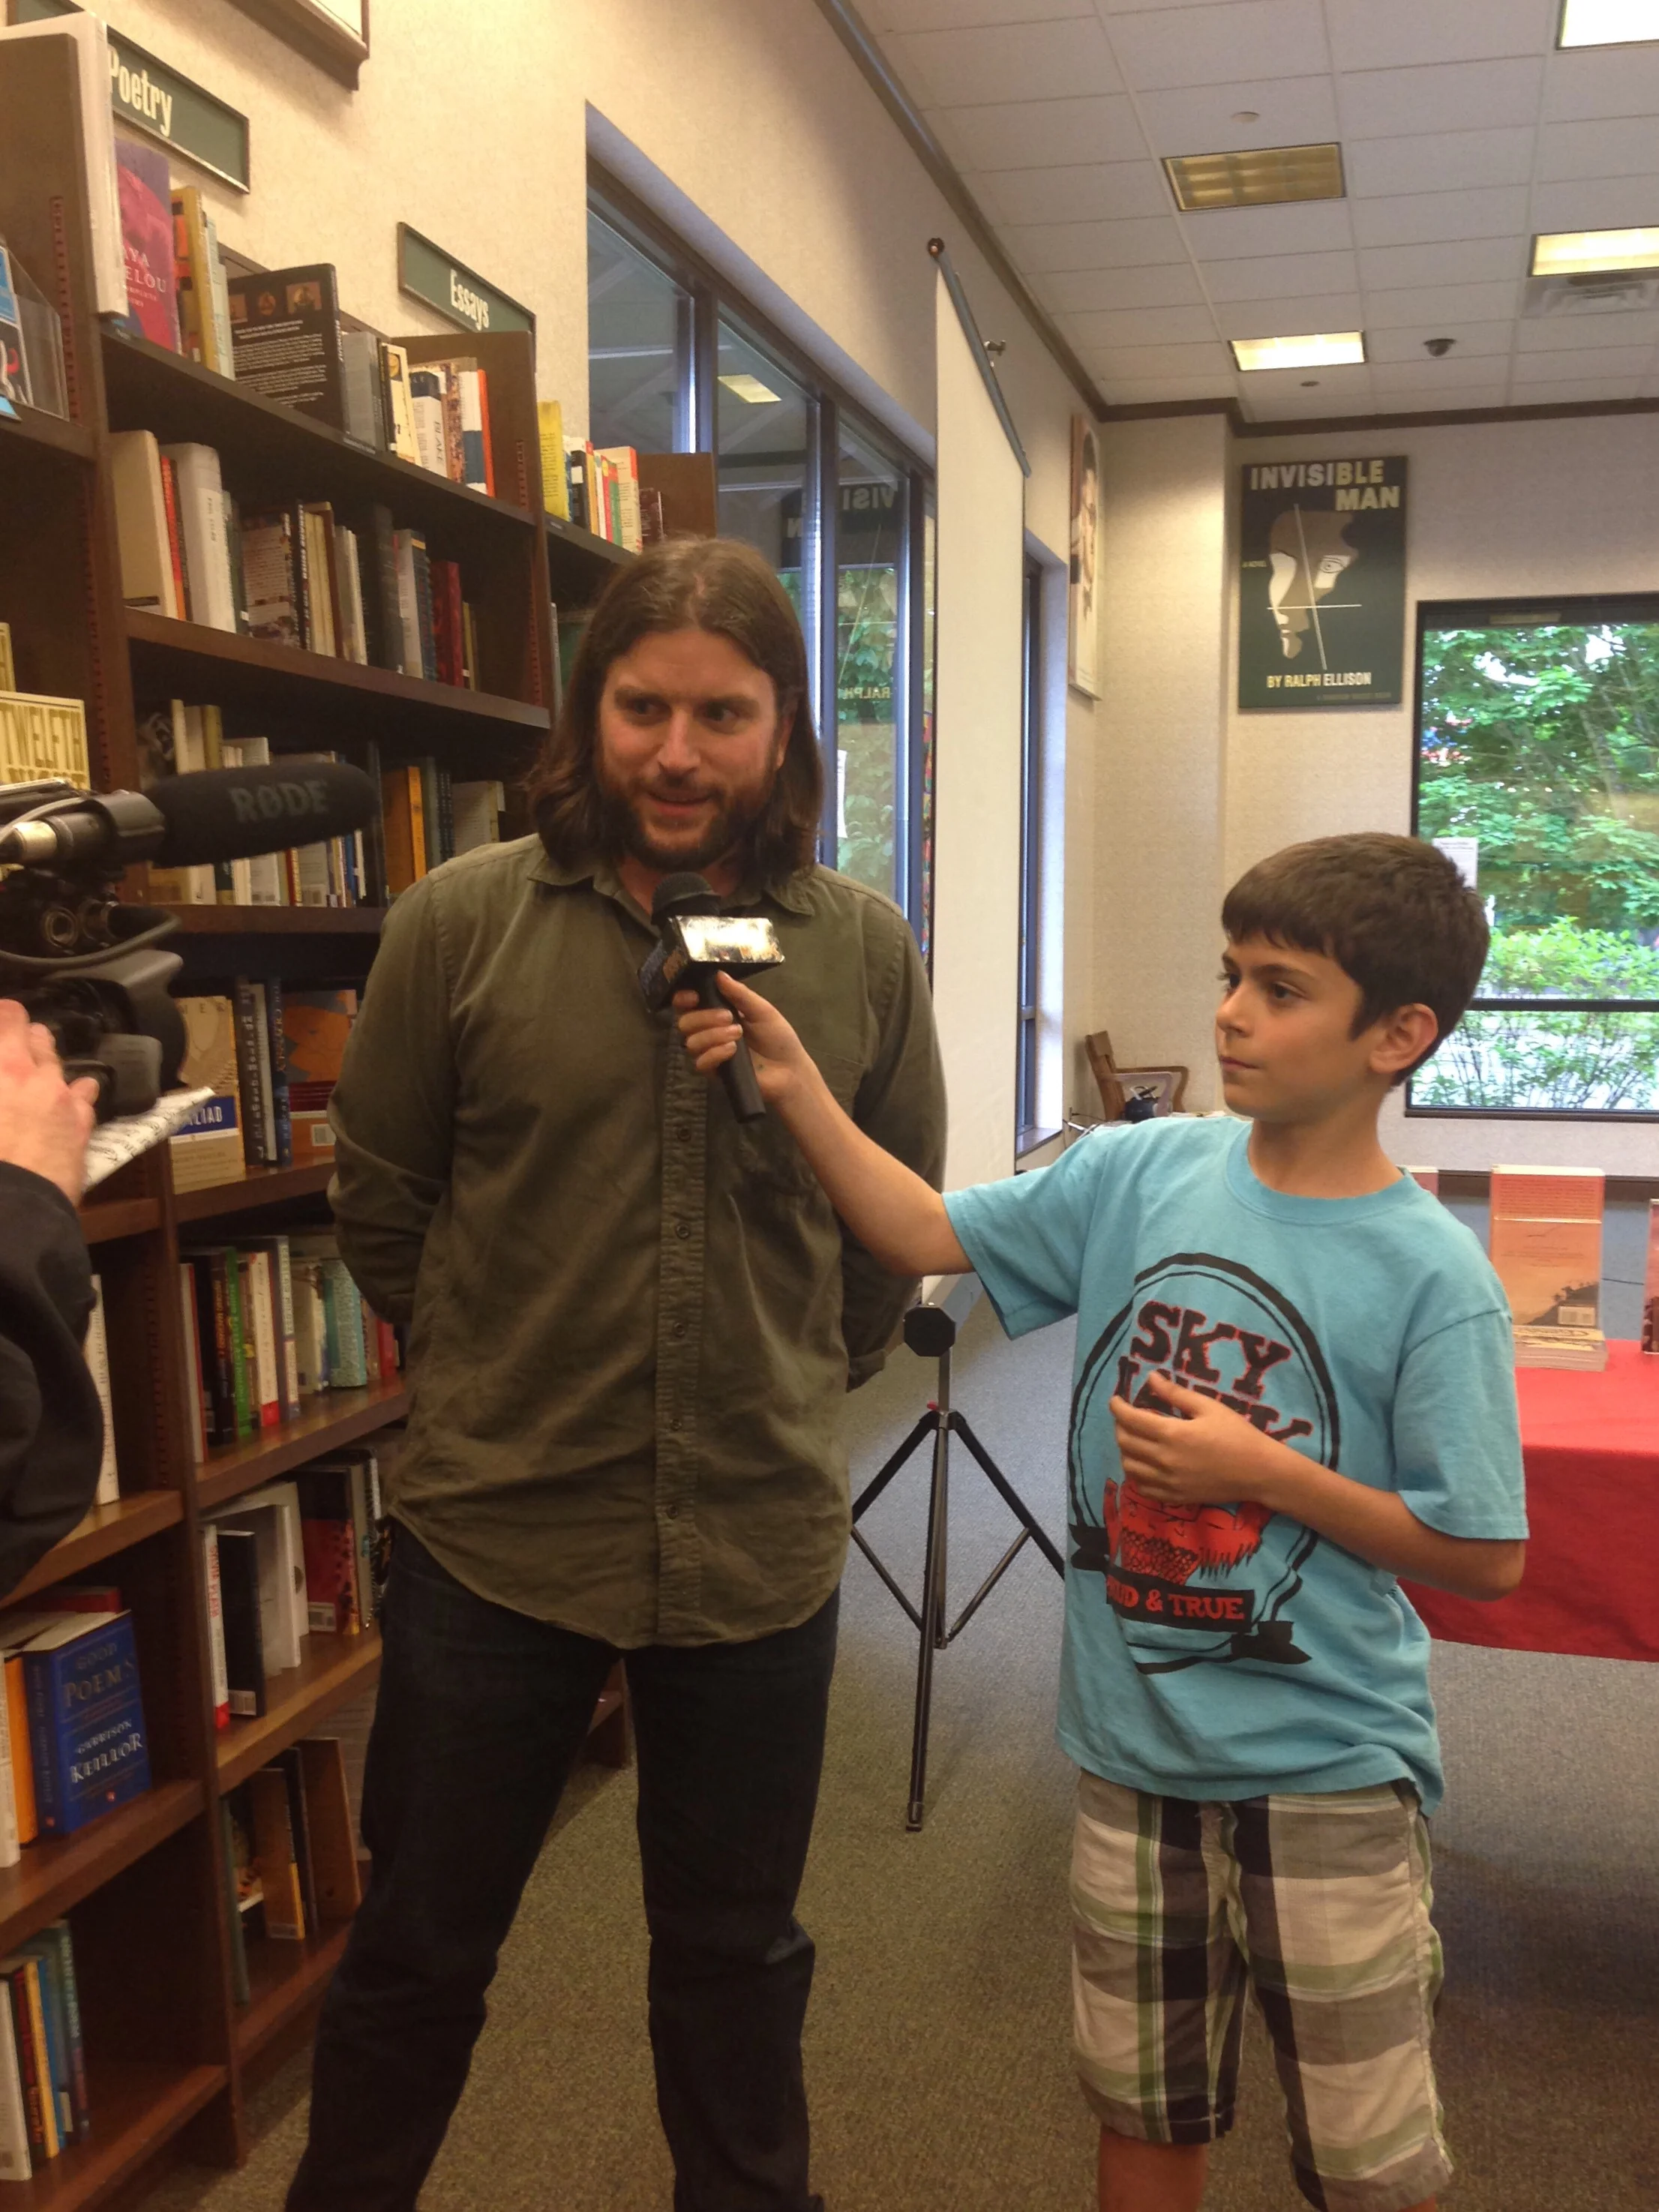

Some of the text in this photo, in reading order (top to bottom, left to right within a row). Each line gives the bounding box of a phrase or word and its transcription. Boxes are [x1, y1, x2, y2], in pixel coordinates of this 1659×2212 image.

[108, 46, 172, 137] Poetry
[126, 265, 166, 292] ELOU
[451, 268, 490, 331] Essays
[1250, 460, 1384, 490] INVISIBLE
[1335, 486, 1400, 511] MAN
[1266, 672, 1372, 688] BY RALPH ELLISON
[1130, 1300, 1292, 1400] SKY
[1145, 1589, 1163, 1612] &
[1167, 1593, 1245, 1620] TRUE
[63, 1654, 136, 1708] POEMS
[69, 1732, 143, 1784] KEILLOR
